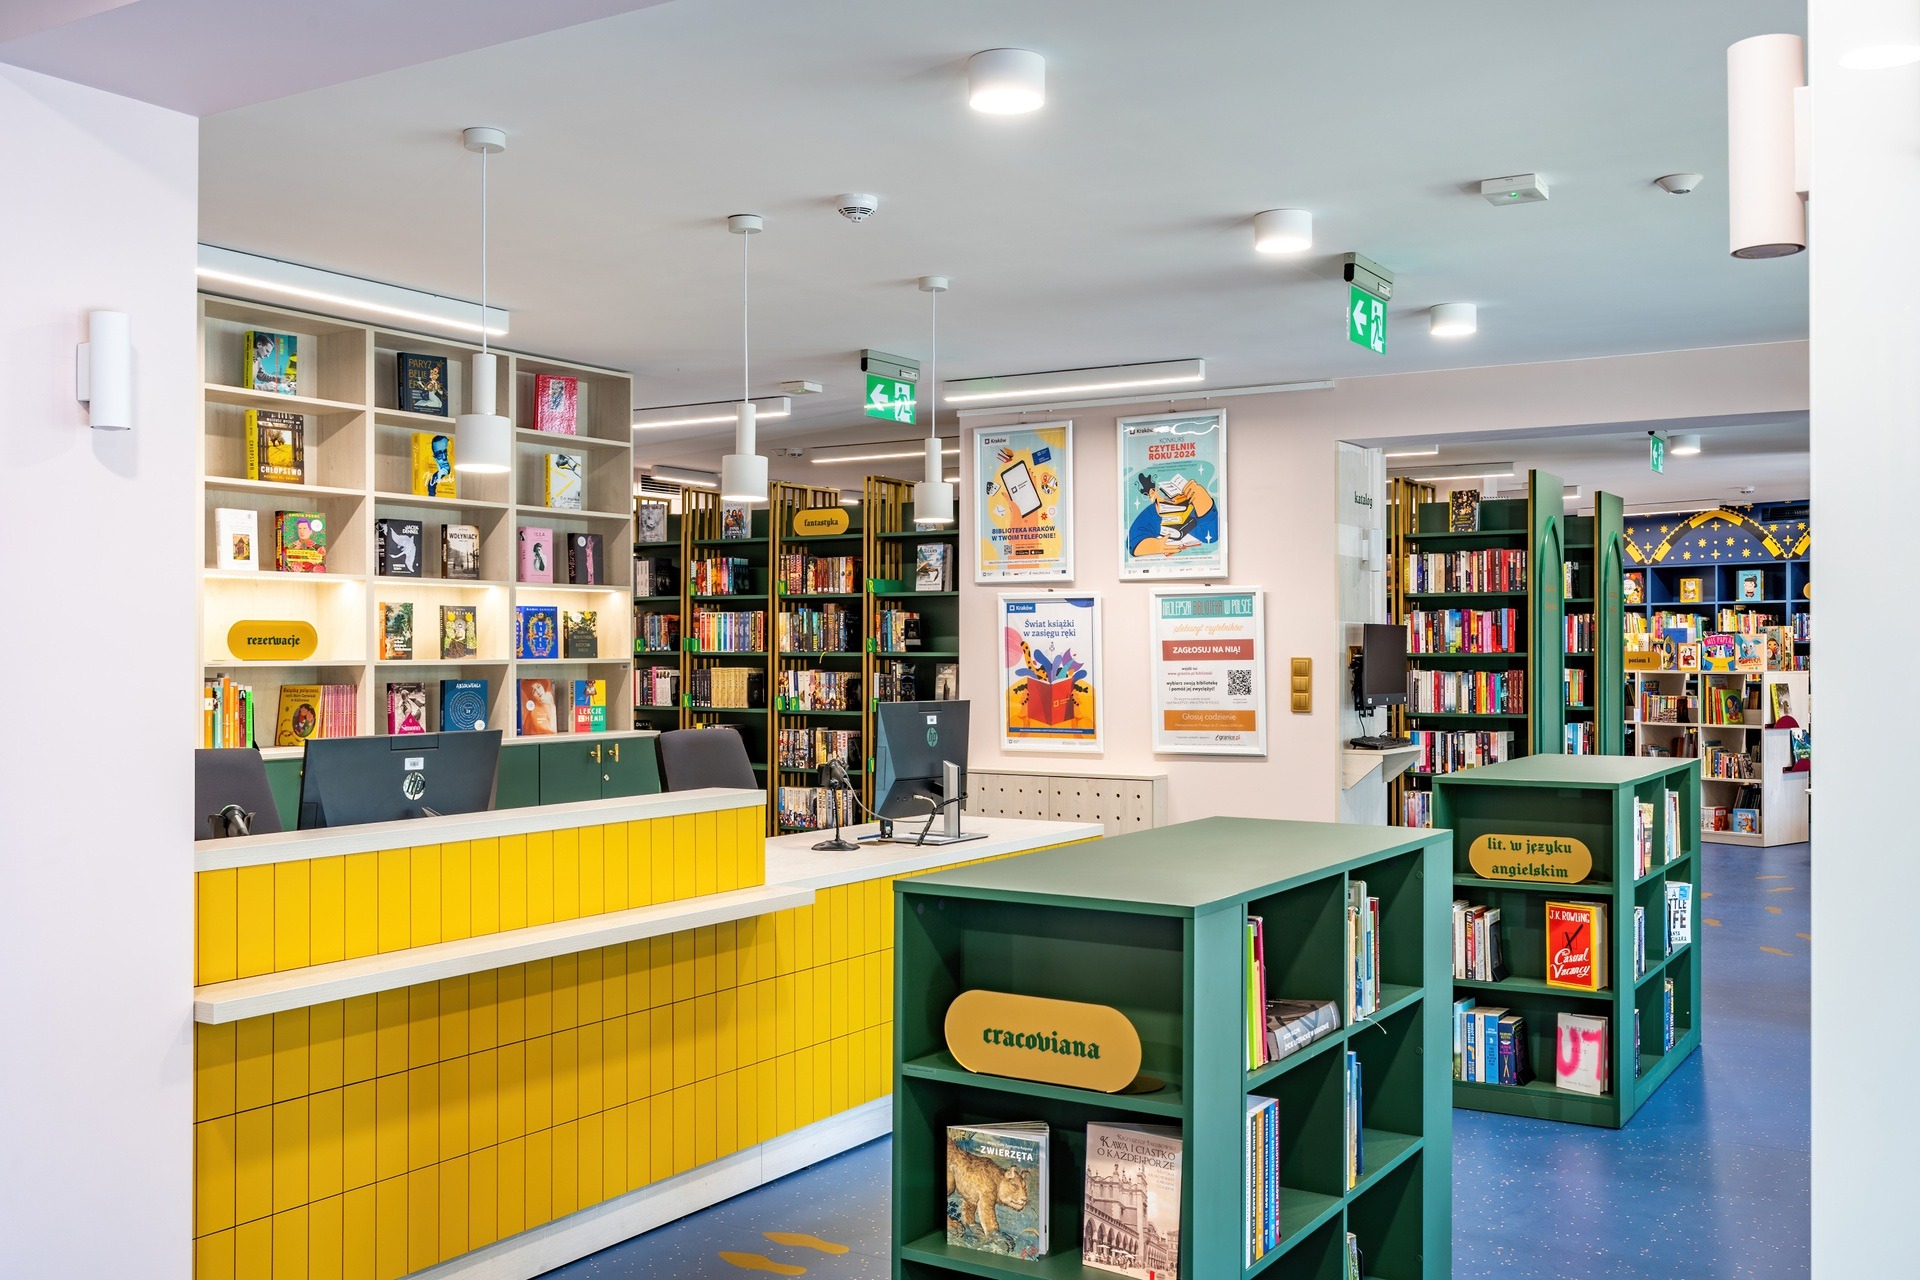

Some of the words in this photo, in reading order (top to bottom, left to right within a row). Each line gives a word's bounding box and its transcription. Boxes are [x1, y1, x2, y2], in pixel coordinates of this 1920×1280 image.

[1148, 442, 1195, 453] CZYTELNIK
[1355, 491, 1373, 509] katalog
[804, 518, 838, 527] fantastyka
[1162, 601, 1192, 616] NAJLEPSZA
[1231, 599, 1251, 614] POLSCE
[1024, 619, 1046, 628] Świat
[1048, 620, 1074, 629] książki
[1032, 629, 1060, 638] zasięgu
[1061, 629, 1076, 638] ręki
[246, 634, 300, 648] rezerwacje
[1225, 646, 1240, 654] NIĄ!
[1182, 712, 1203, 722] Głosuj
[1487, 837, 1506, 850] lit.
[1510, 840, 1522, 851] w
[1525, 839, 1572, 855] języku
[1492, 863, 1568, 878] angielskim
[1561, 911, 1590, 923] ROWLING
[1554, 947, 1589, 966] Casual
[1550, 965, 1591, 978] Vacancy
[982, 1026, 1101, 1060] cracoviana
[980, 1145, 1033, 1162] ZWIERZĘTA
[1100, 1136, 1131, 1153] KAWA
[1135, 1145, 1176, 1160] CIASTKO
[1142, 1157, 1175, 1171] PORZE
